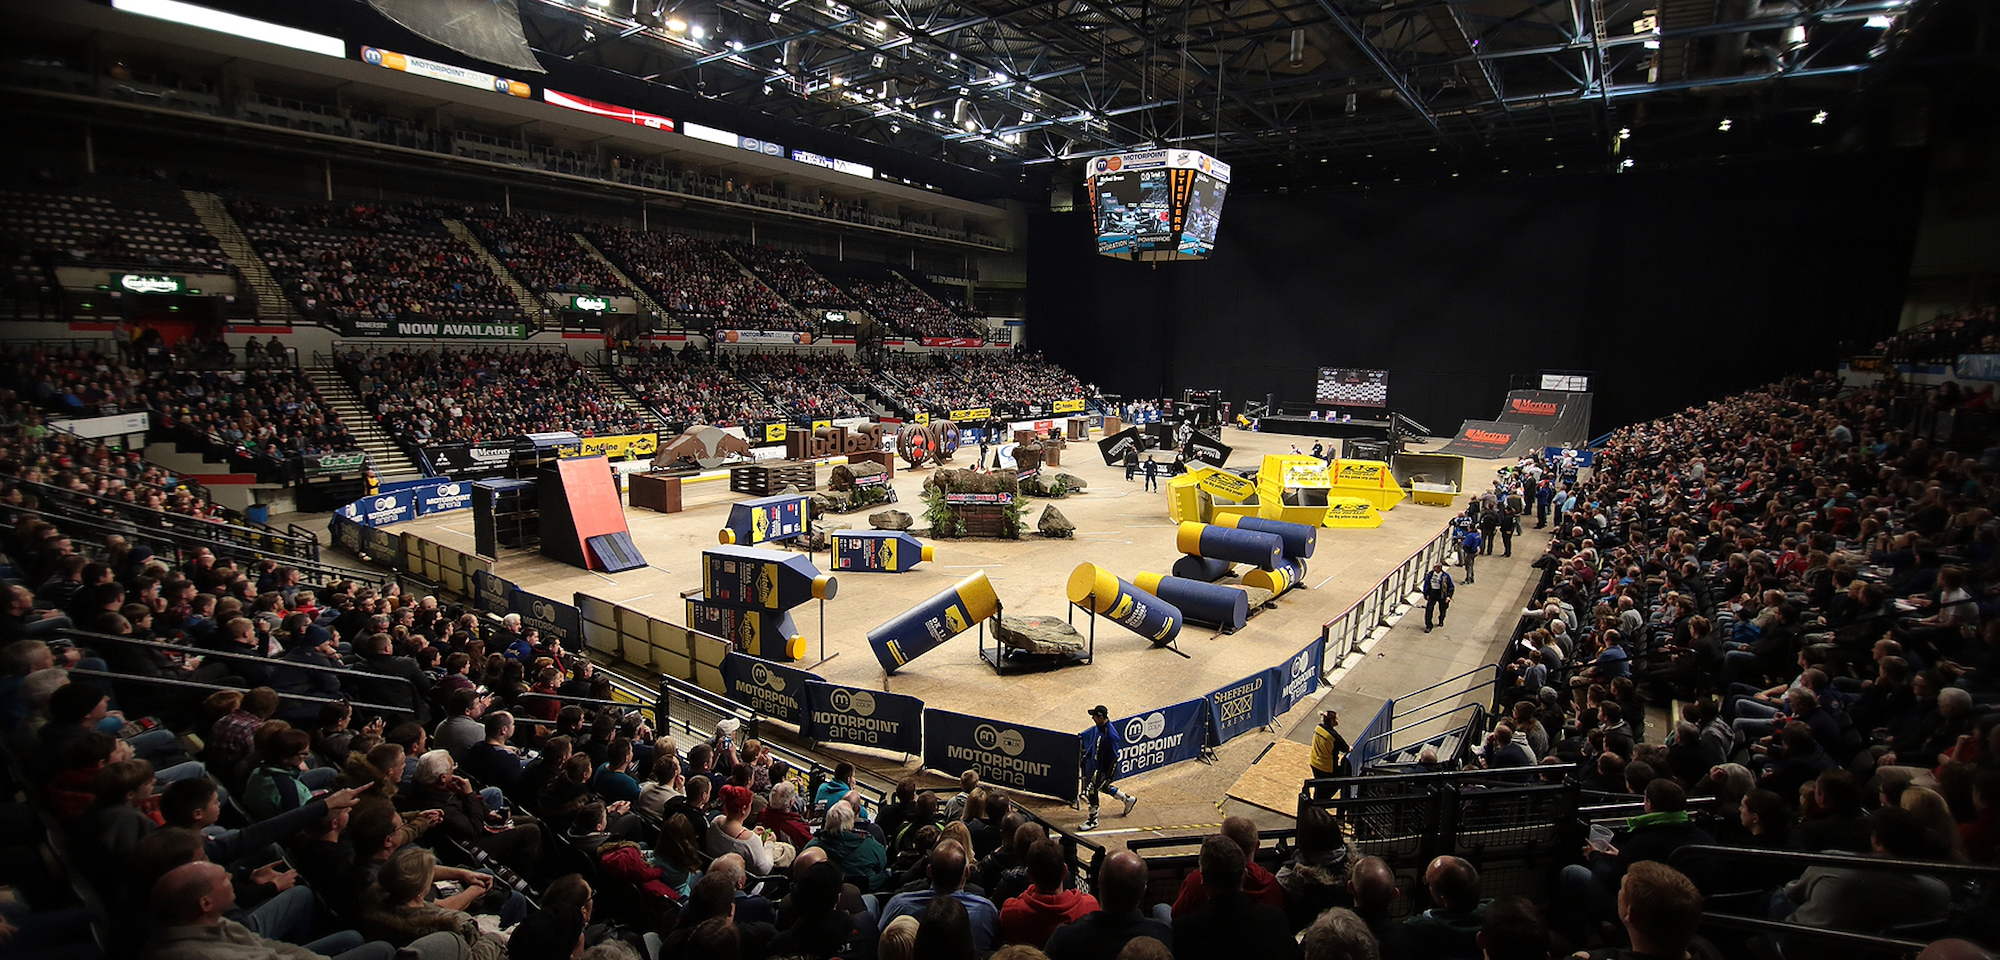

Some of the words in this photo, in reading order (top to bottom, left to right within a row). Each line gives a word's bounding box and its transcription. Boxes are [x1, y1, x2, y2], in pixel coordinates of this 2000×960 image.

[1123, 150, 1167, 161] MOTORPOINT
[1173, 169, 1186, 231] STEELERS
[398, 322, 438, 335] NOW
[442, 324, 519, 337] AVAILABLE
[1521, 399, 1558, 410] Mertrux
[1473, 429, 1511, 440] Mertrux
[478, 448, 511, 457] Mertrux
[585, 442, 618, 453] Putline
[426, 494, 471, 505] MOTORPOINT
[437, 501, 462, 510] arena
[375, 513, 399, 525] arena
[759, 565, 771, 605] Putoline
[523, 615, 568, 638] MOTORPOINT
[741, 612, 752, 650] Putoline
[931, 616, 942, 630] DX
[1213, 677, 1263, 705] SHEFFIELD
[1281, 665, 1316, 698] MOTORPOINT
[1290, 681, 1307, 702] arena
[751, 696, 788, 718] arena
[811, 710, 900, 734] MOTORPOINT
[1221, 712, 1252, 730] ARENA
[829, 725, 878, 744] arena
[948, 745, 1051, 777] MOTORPOINT
[1120, 751, 1165, 774] arena
[971, 762, 1025, 786] arena
